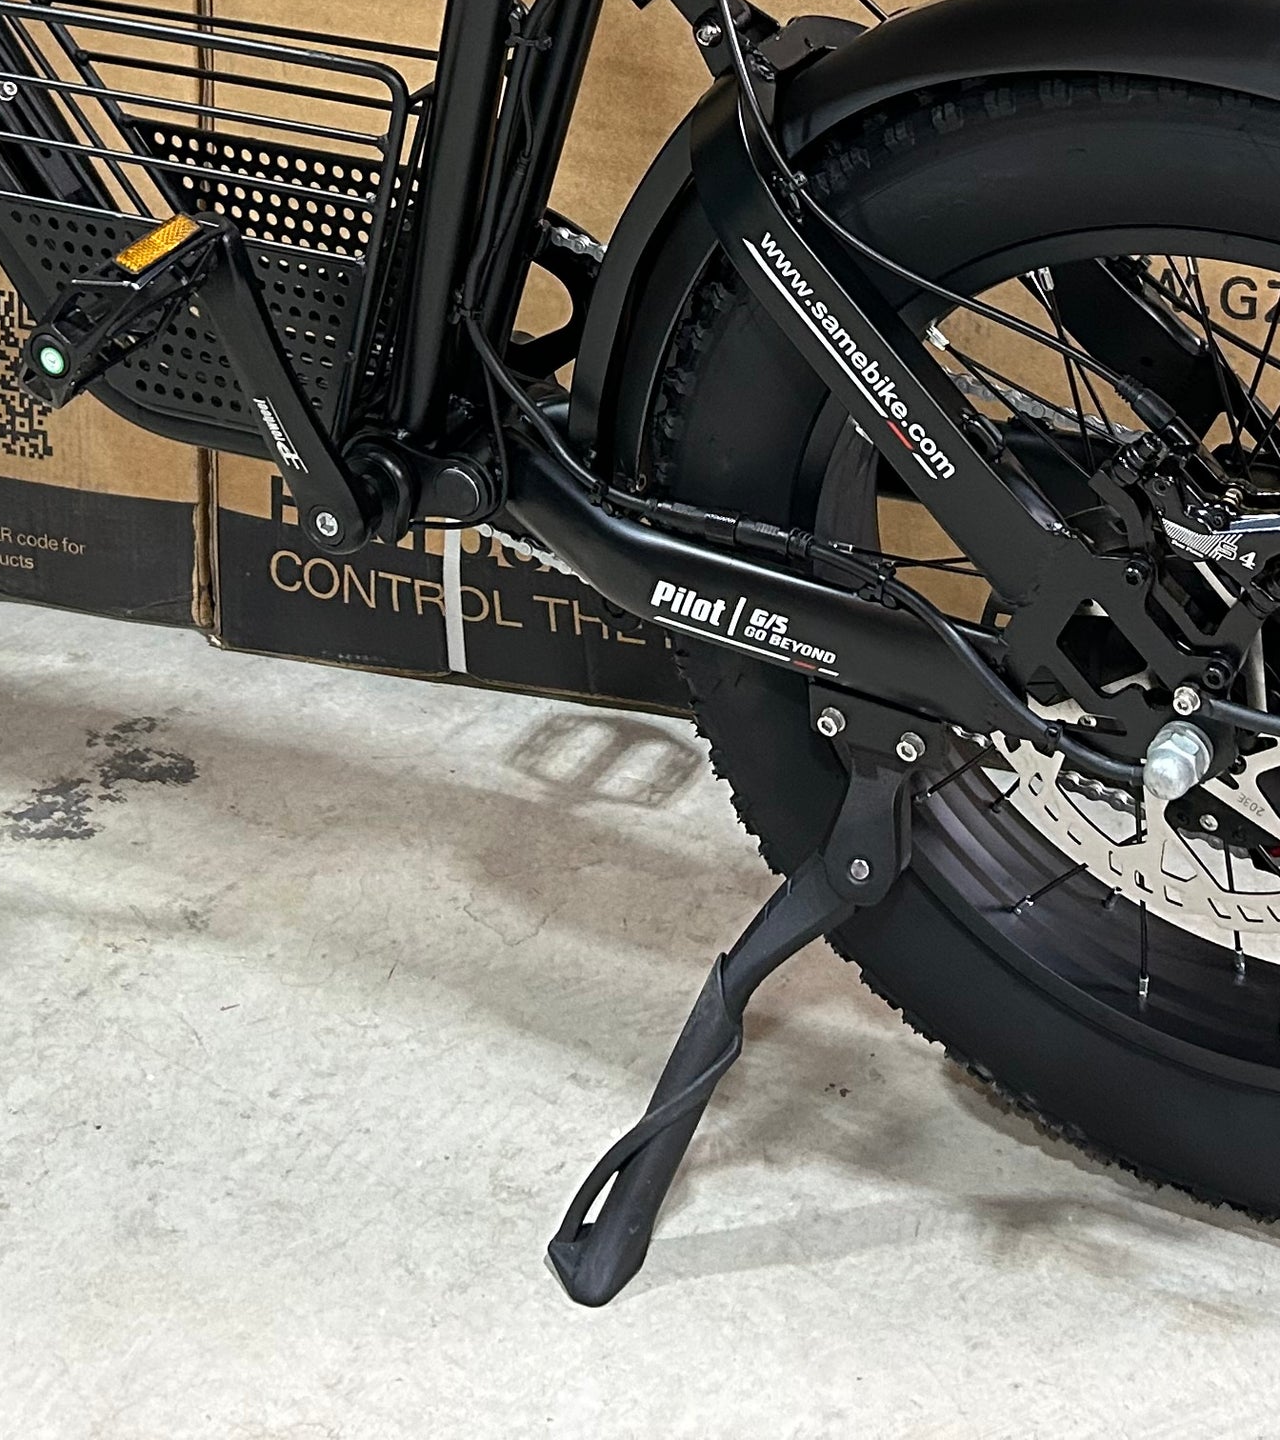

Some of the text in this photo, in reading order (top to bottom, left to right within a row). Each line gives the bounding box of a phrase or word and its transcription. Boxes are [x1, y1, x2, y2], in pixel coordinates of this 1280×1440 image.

[760, 232, 956, 480] www.samebike.com
[16, 531, 59, 552] code
[62, 536, 87, 556] for
[270, 548, 524, 629] CONTROL
[650, 579, 790, 635] Pilot G/S
[743, 625, 837, 665] GO BEYOND
